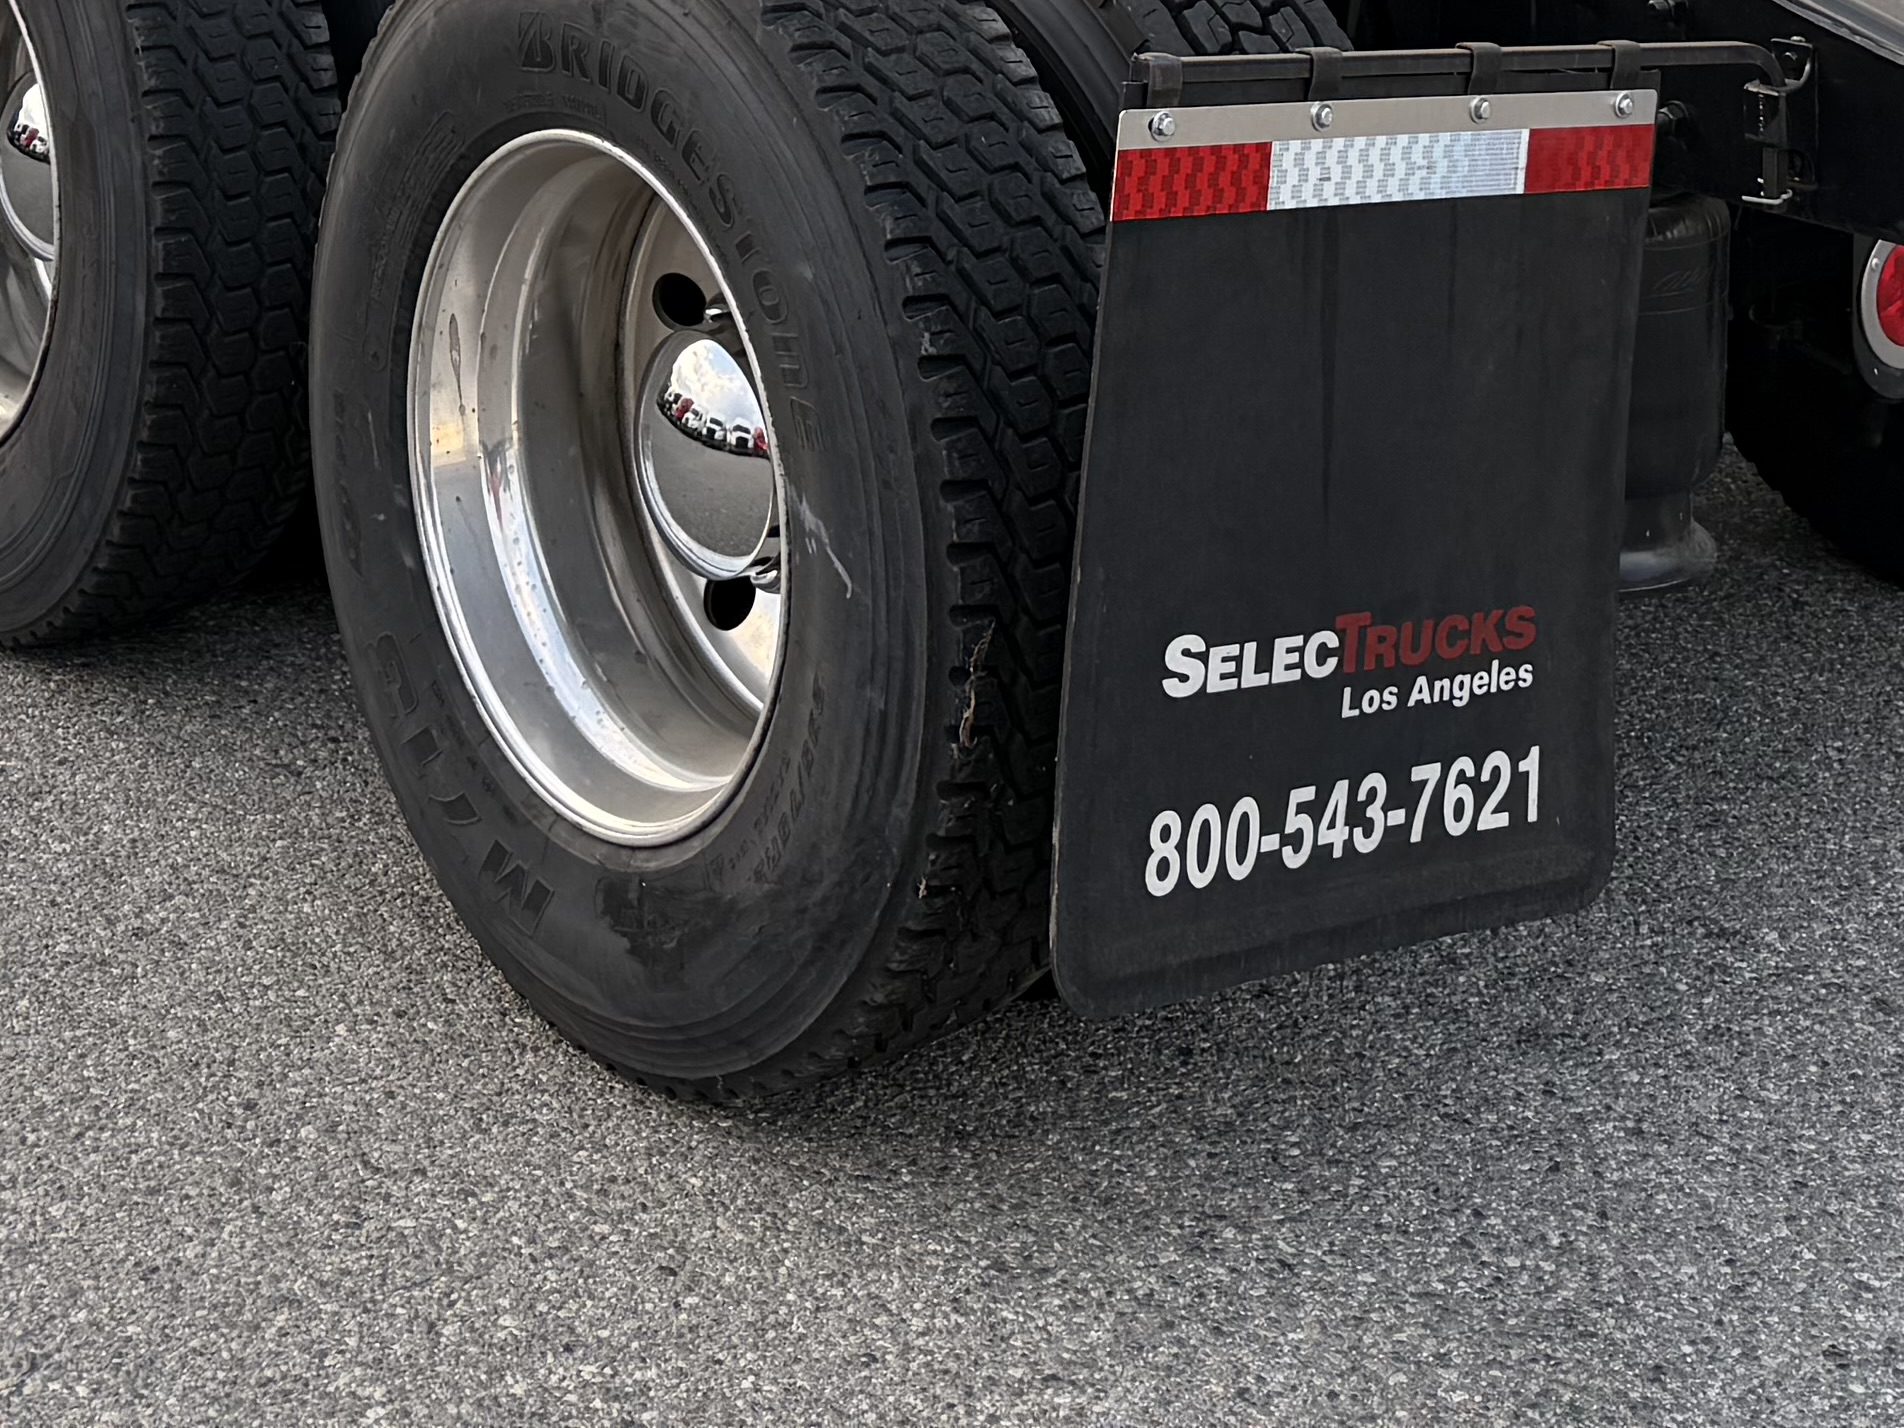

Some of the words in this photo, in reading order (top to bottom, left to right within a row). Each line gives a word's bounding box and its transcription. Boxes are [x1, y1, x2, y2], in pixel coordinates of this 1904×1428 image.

[1162, 605, 1536, 698] SELECTRUCKS
[1341, 686, 1399, 719] Los
[1407, 658, 1534, 708] Angeles
[1144, 745, 1541, 897] 800-543-7621
